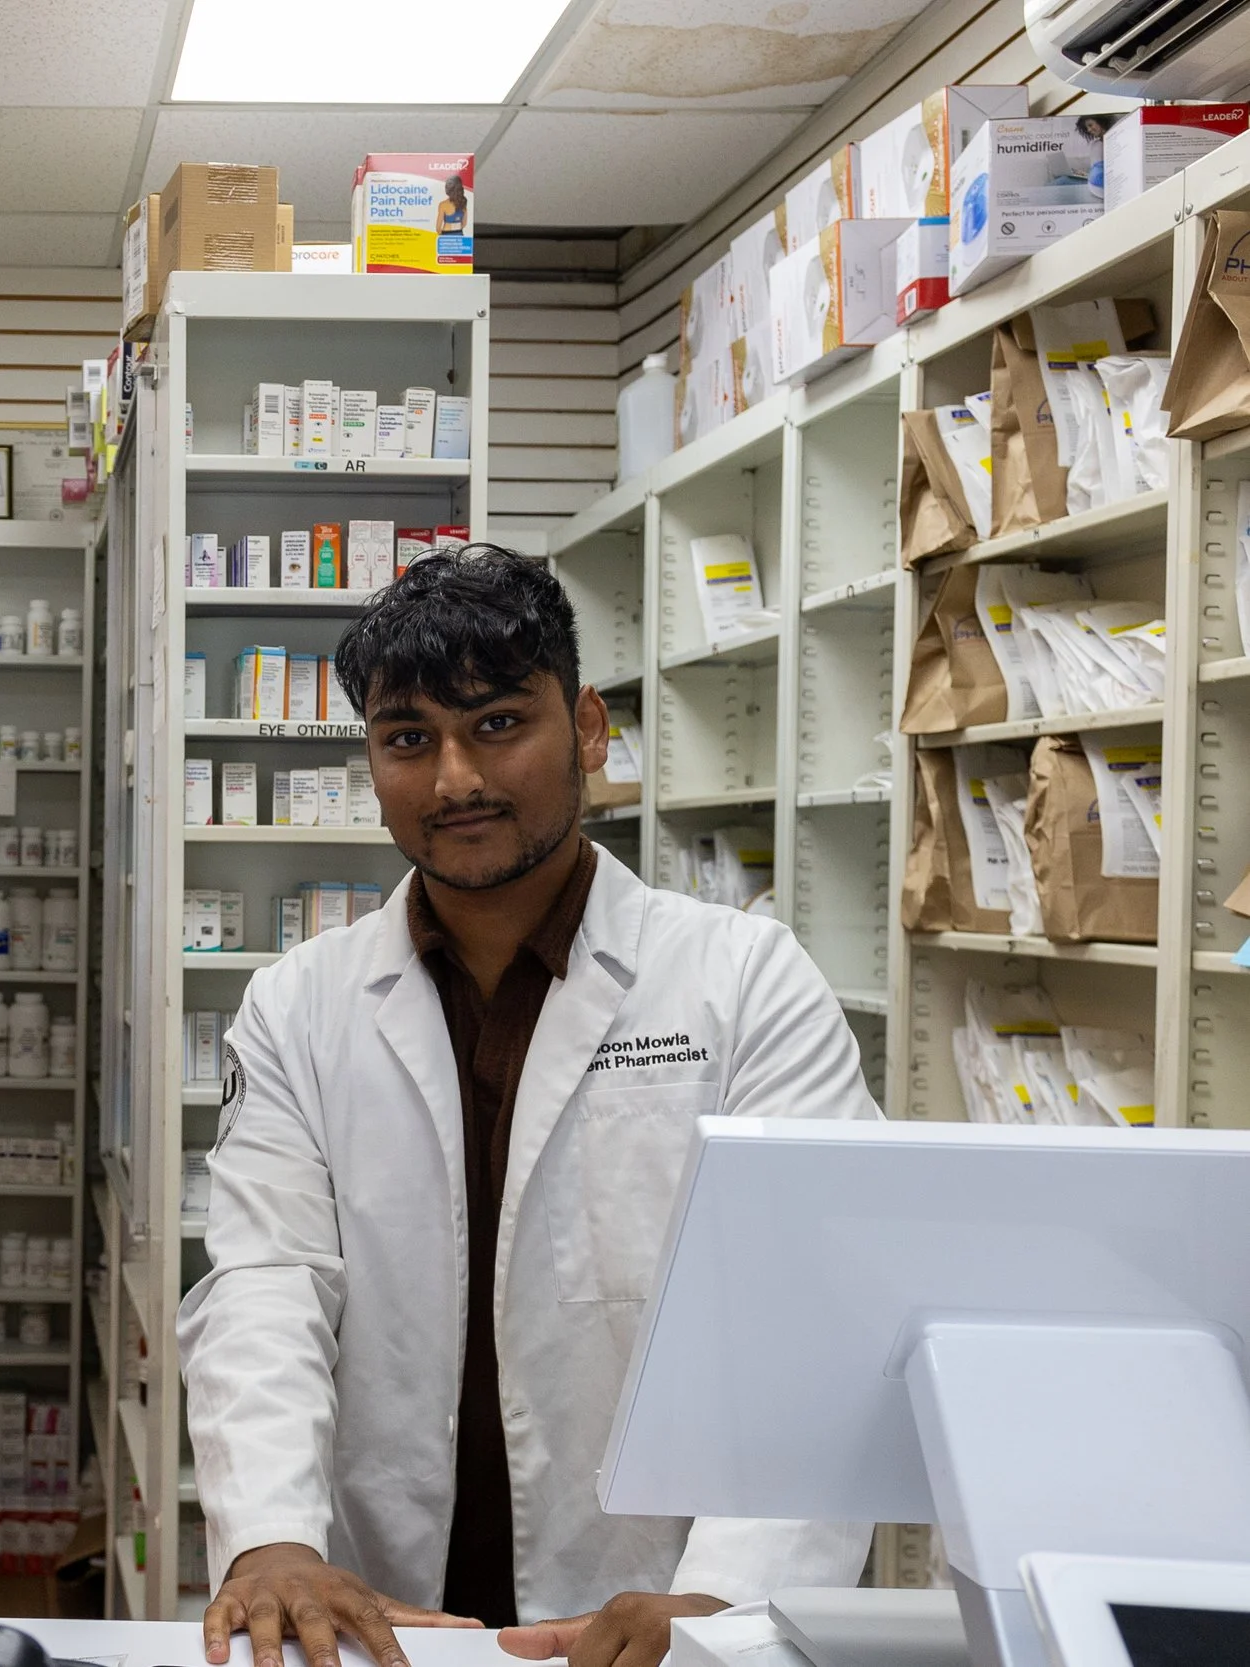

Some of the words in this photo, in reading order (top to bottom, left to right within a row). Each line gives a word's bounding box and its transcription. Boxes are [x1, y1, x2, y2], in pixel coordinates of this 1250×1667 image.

[1203, 113, 1238, 121] LEADER
[997, 141, 1064, 154] humidifier
[370, 184, 428, 195] Lidocaine
[370, 196, 396, 206] Pain
[399, 195, 433, 206] Relief
[370, 207, 403, 217] Patch
[1036, 209, 1066, 217] personal
[123, 355, 133, 393] Contour
[345, 460, 366, 472] AR
[259, 723, 286, 736] EYE
[636, 1032, 690, 1050] Mowla
[614, 1048, 709, 1068] Pharmacist
